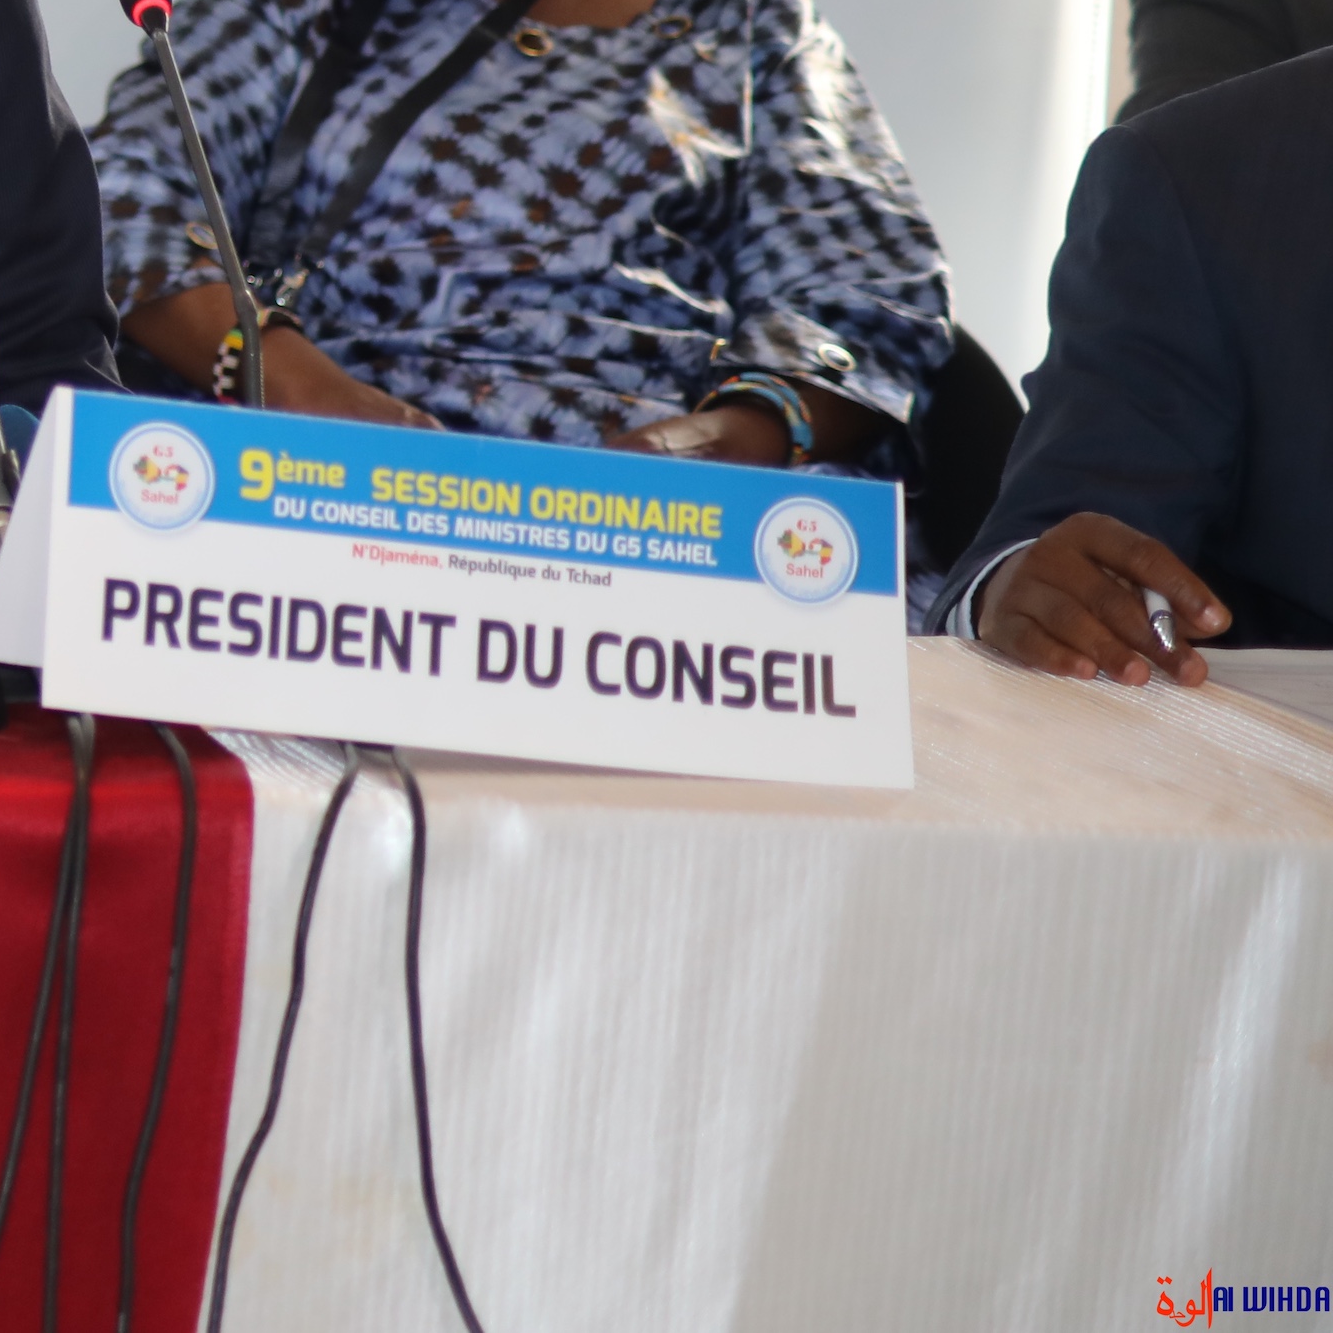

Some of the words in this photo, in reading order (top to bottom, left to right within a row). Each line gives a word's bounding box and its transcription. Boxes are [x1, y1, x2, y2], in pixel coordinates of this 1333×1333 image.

[140, 489, 179, 504] Sahel
[239, 447, 346, 502] 9ème
[371, 467, 521, 517] SESSION
[529, 486, 723, 539] ORDINAIRE
[273, 496, 307, 520] DU
[310, 500, 402, 531] CONSEIL
[406, 510, 450, 537] DES
[454, 516, 571, 551] MINISTRES
[575, 530, 608, 555] DU
[612, 534, 642, 559] G5
[647, 539, 719, 567] SAHEL
[351, 543, 444, 570] N'Djaména,
[448, 554, 537, 582] République
[541, 565, 561, 582] du
[566, 567, 613, 587] Tchad
[785, 562, 824, 578] Sahel
[101, 577, 456, 676] PRESIDENT
[477, 619, 563, 688] DU
[585, 630, 857, 718] CONSEIL
